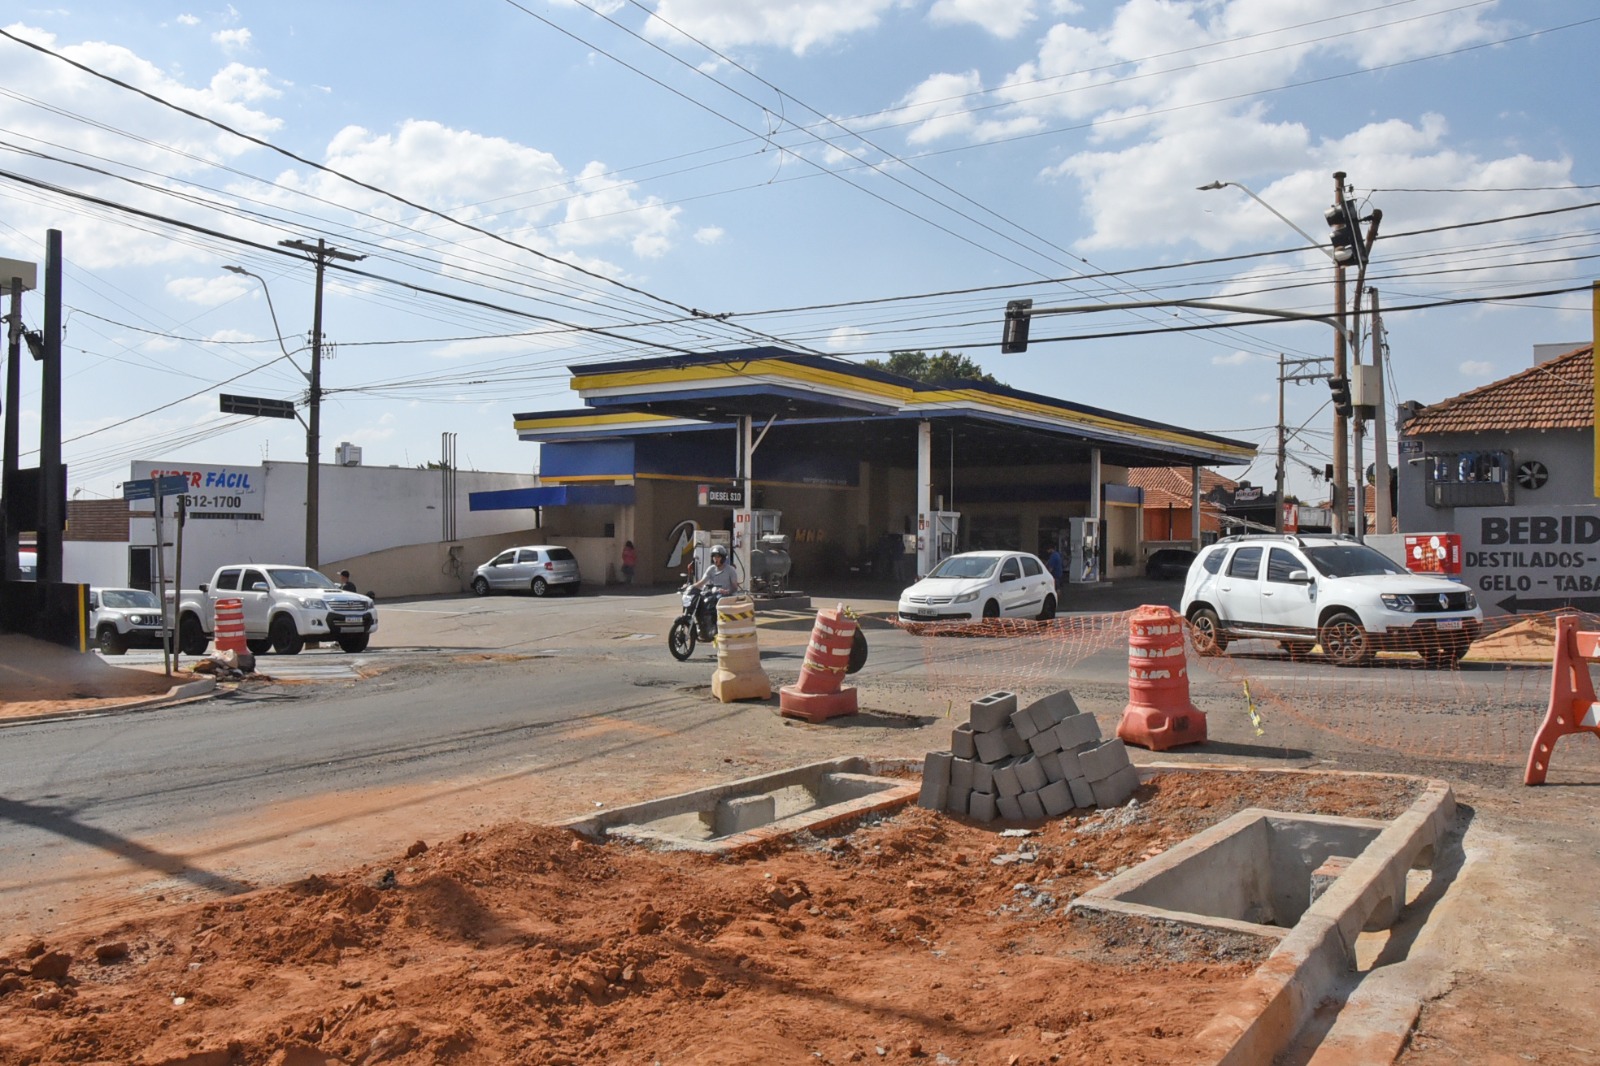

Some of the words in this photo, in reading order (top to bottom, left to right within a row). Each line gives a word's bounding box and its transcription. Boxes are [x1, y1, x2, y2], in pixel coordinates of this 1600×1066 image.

[205, 469, 250, 489] FÁCIL
[709, 491, 730, 501] DIESEL
[1481, 515, 1600, 545] BEBID
[1479, 575, 1531, 591] GELO
